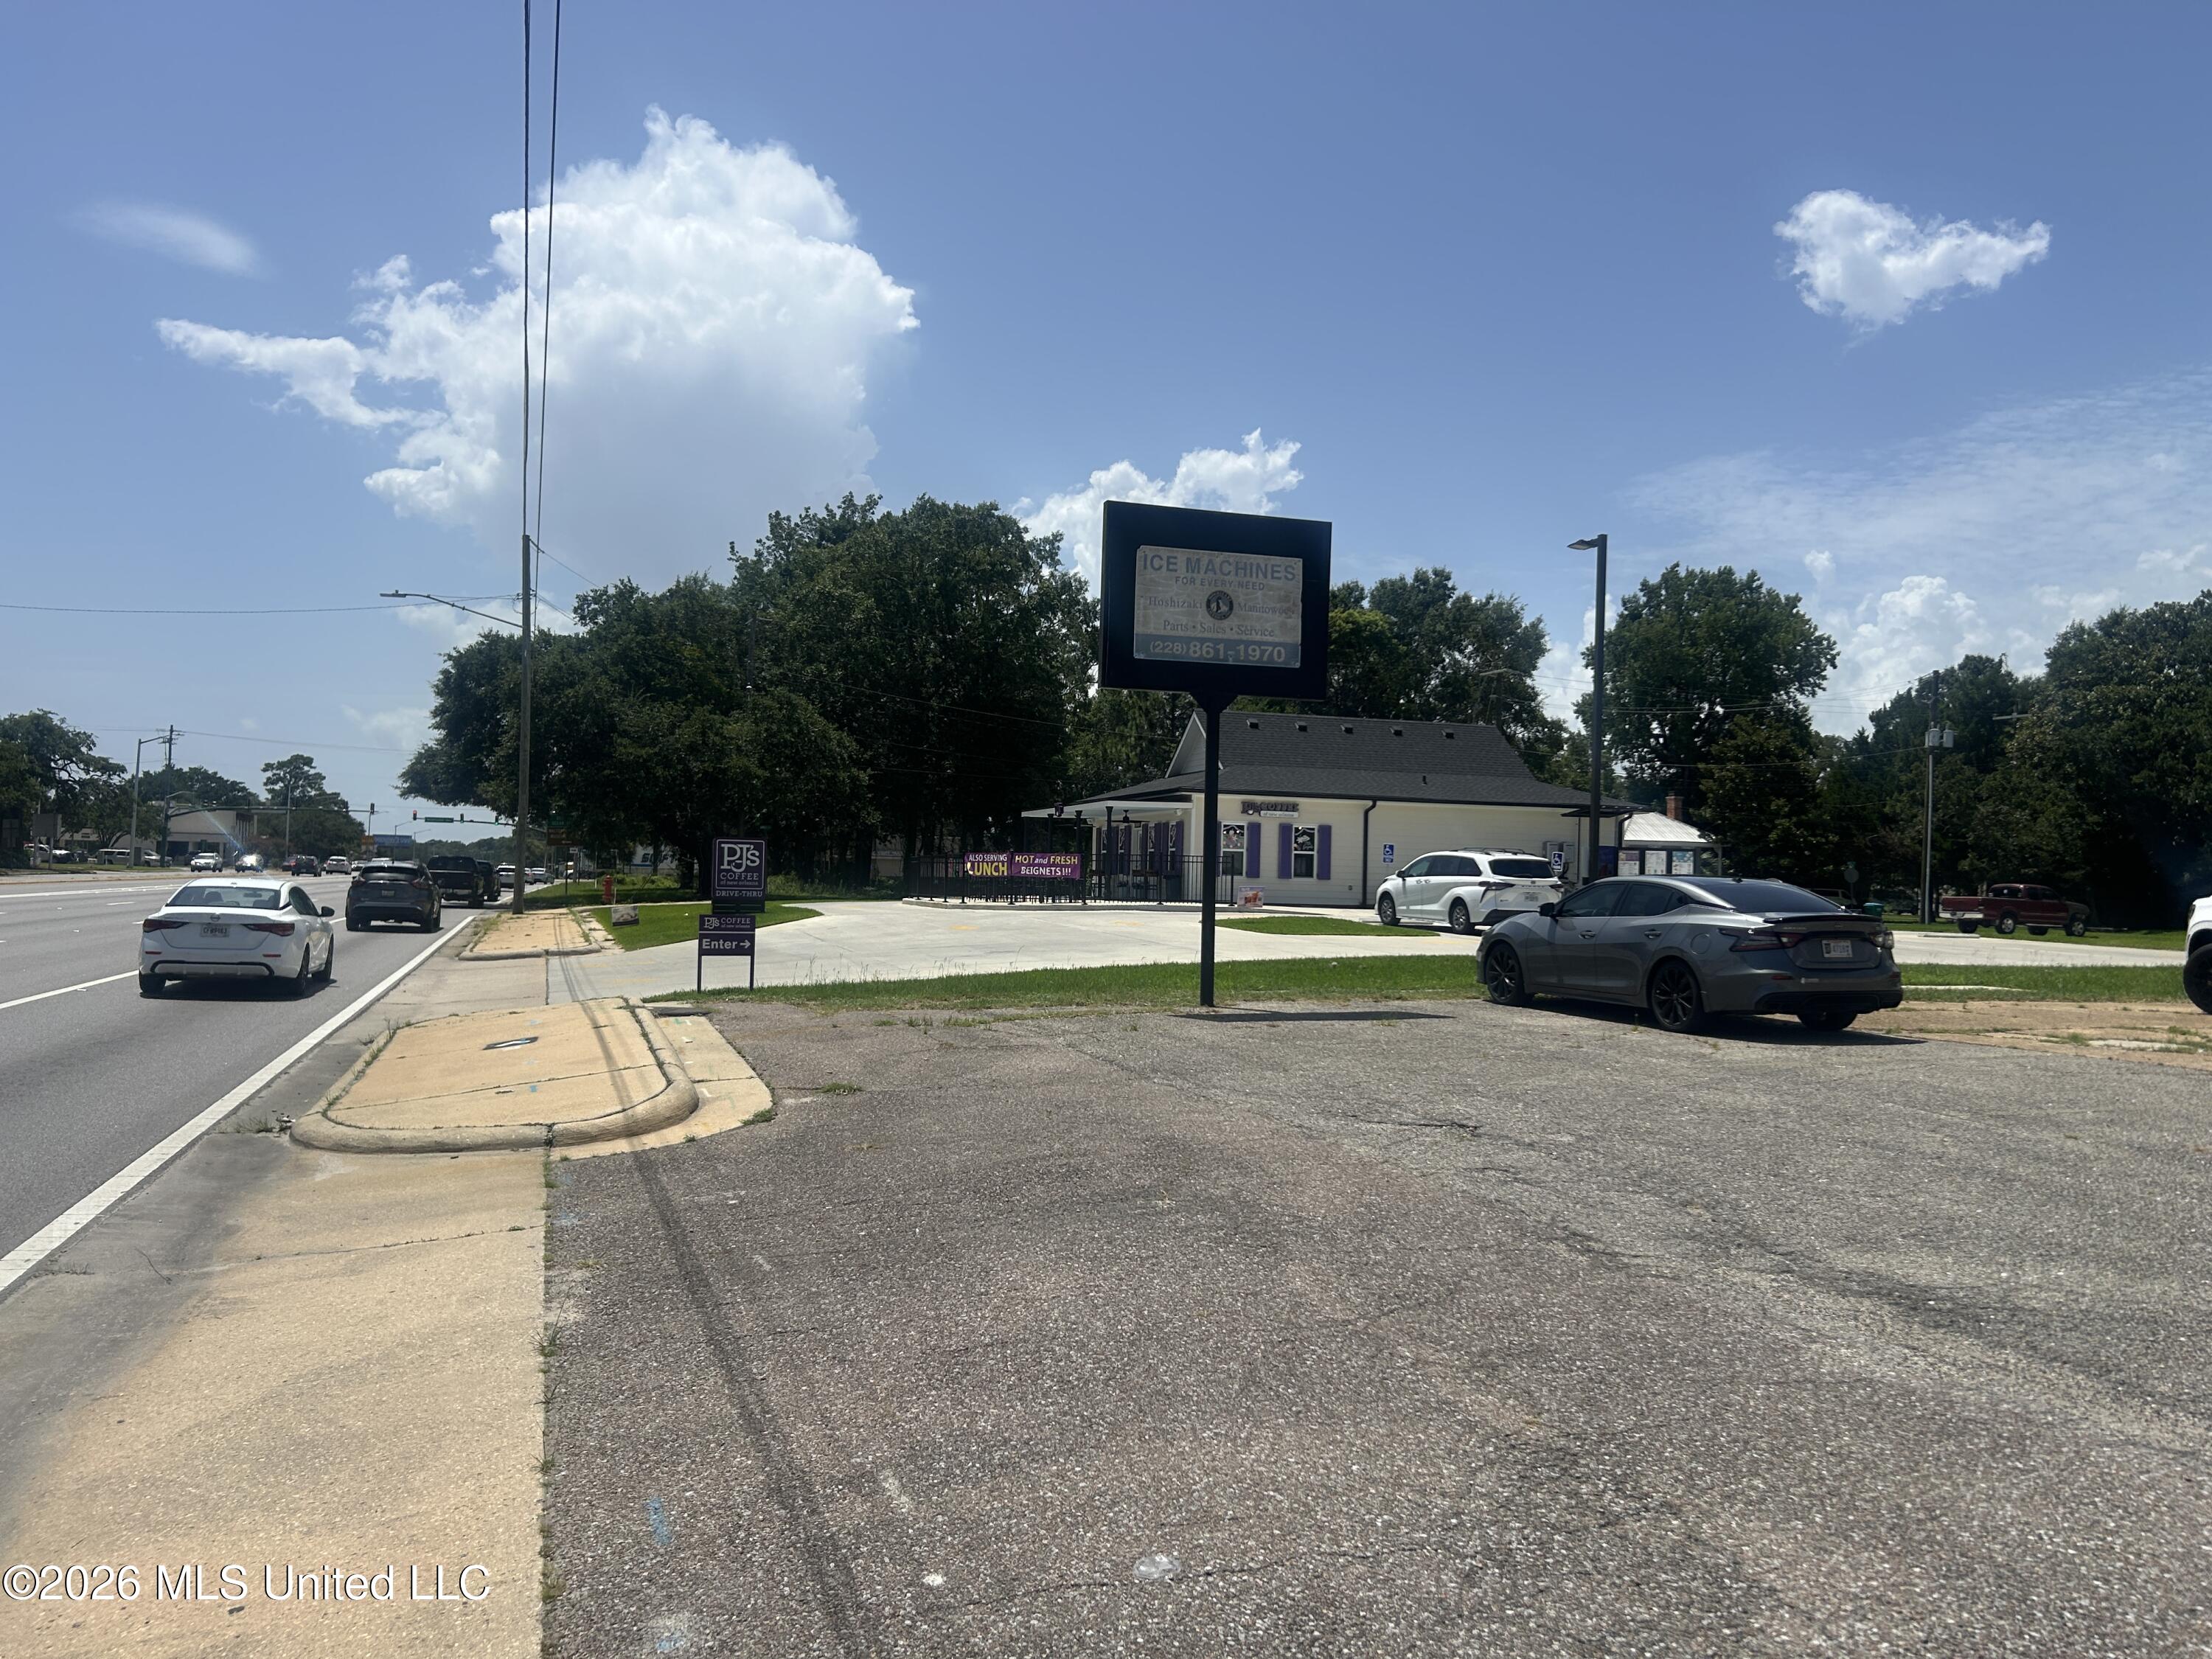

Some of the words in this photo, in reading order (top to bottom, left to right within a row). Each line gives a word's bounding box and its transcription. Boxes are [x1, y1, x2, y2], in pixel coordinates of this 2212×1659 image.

[1142, 553, 1178, 572] ICE
[1186, 557, 1296, 581] MACHINES
[1175, 576, 1195, 586] FOR
[1200, 577, 1233, 588] EVERY
[1237, 580, 1265, 591] NEED
[1149, 596, 1203, 610] Hoshizaki
[1163, 620, 1189, 632] Parts
[1200, 622, 1226, 633] Sales
[1237, 625, 1275, 637] Service
[1150, 641, 1186, 655] (228)
[1189, 641, 1286, 662] 861-1970
[720, 844, 760, 872] PJ's
[968, 854, 983, 862] ALSO
[984, 854, 1007, 862] SERVING
[1015, 855, 1034, 864] HOT
[1050, 855, 1078, 865] FRESH
[720, 872, 759, 880] COFFEE
[967, 862, 1007, 876] LUNCH
[702, 938, 738, 949] Enter
